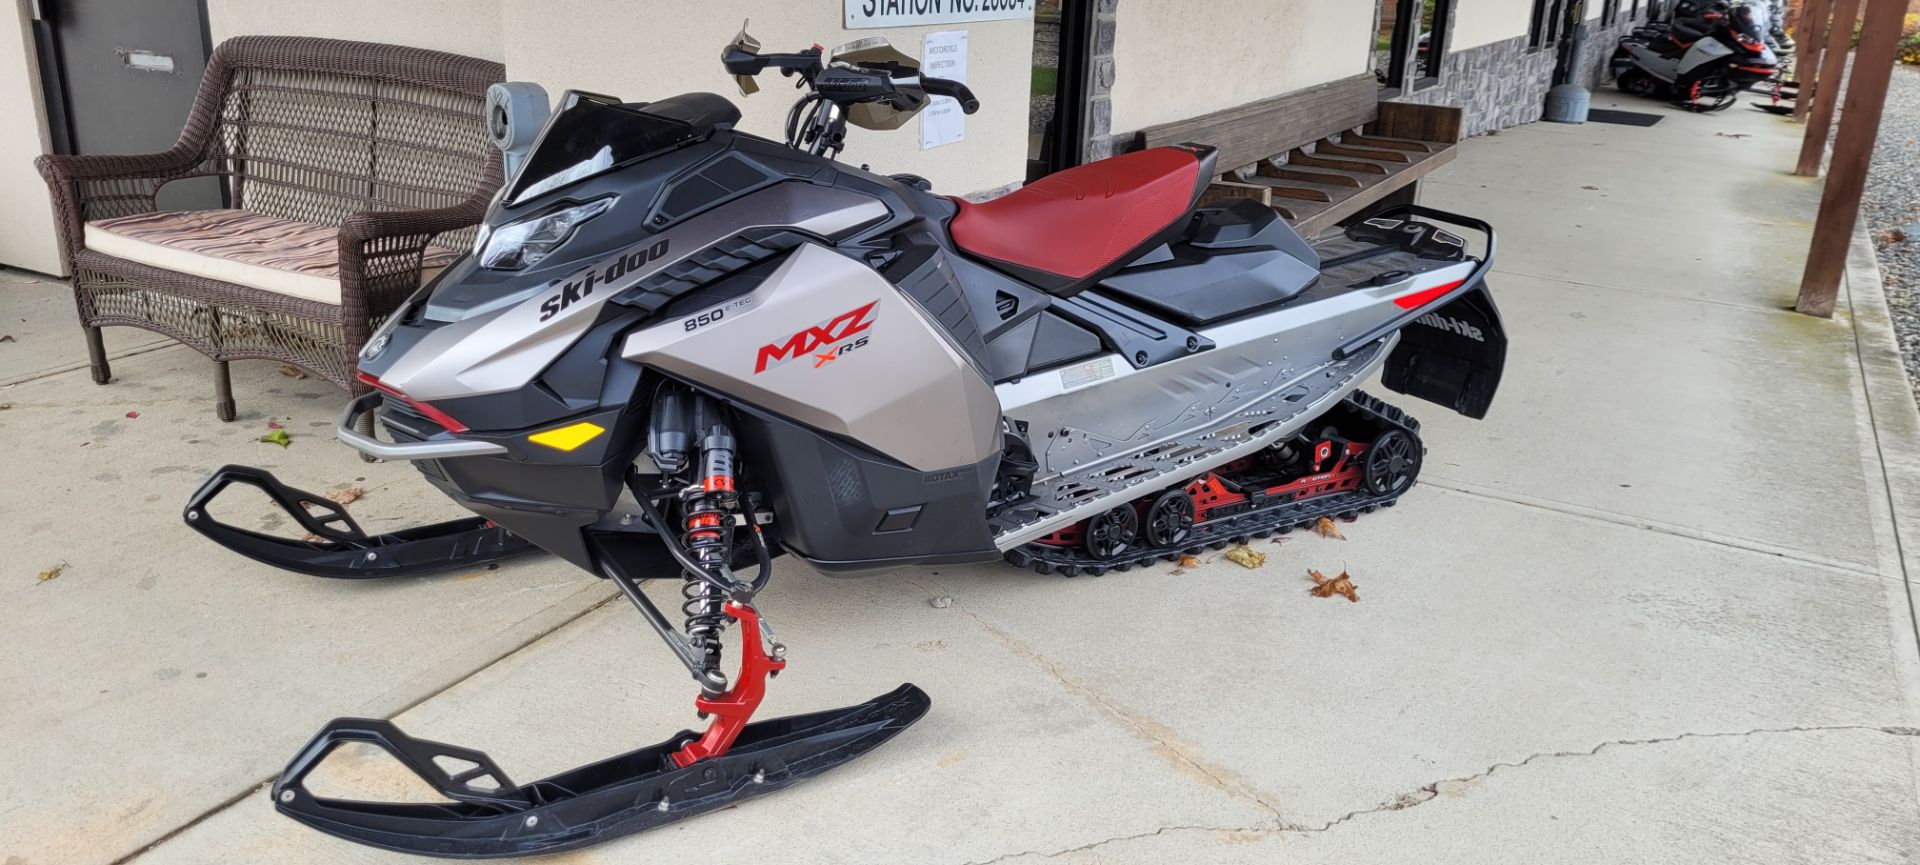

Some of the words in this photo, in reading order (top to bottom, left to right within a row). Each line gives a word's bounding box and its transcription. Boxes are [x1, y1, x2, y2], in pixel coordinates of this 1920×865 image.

[540, 238, 670, 322] ski-doo
[685, 309, 724, 332] 850
[754, 299, 880, 375] MXZ
